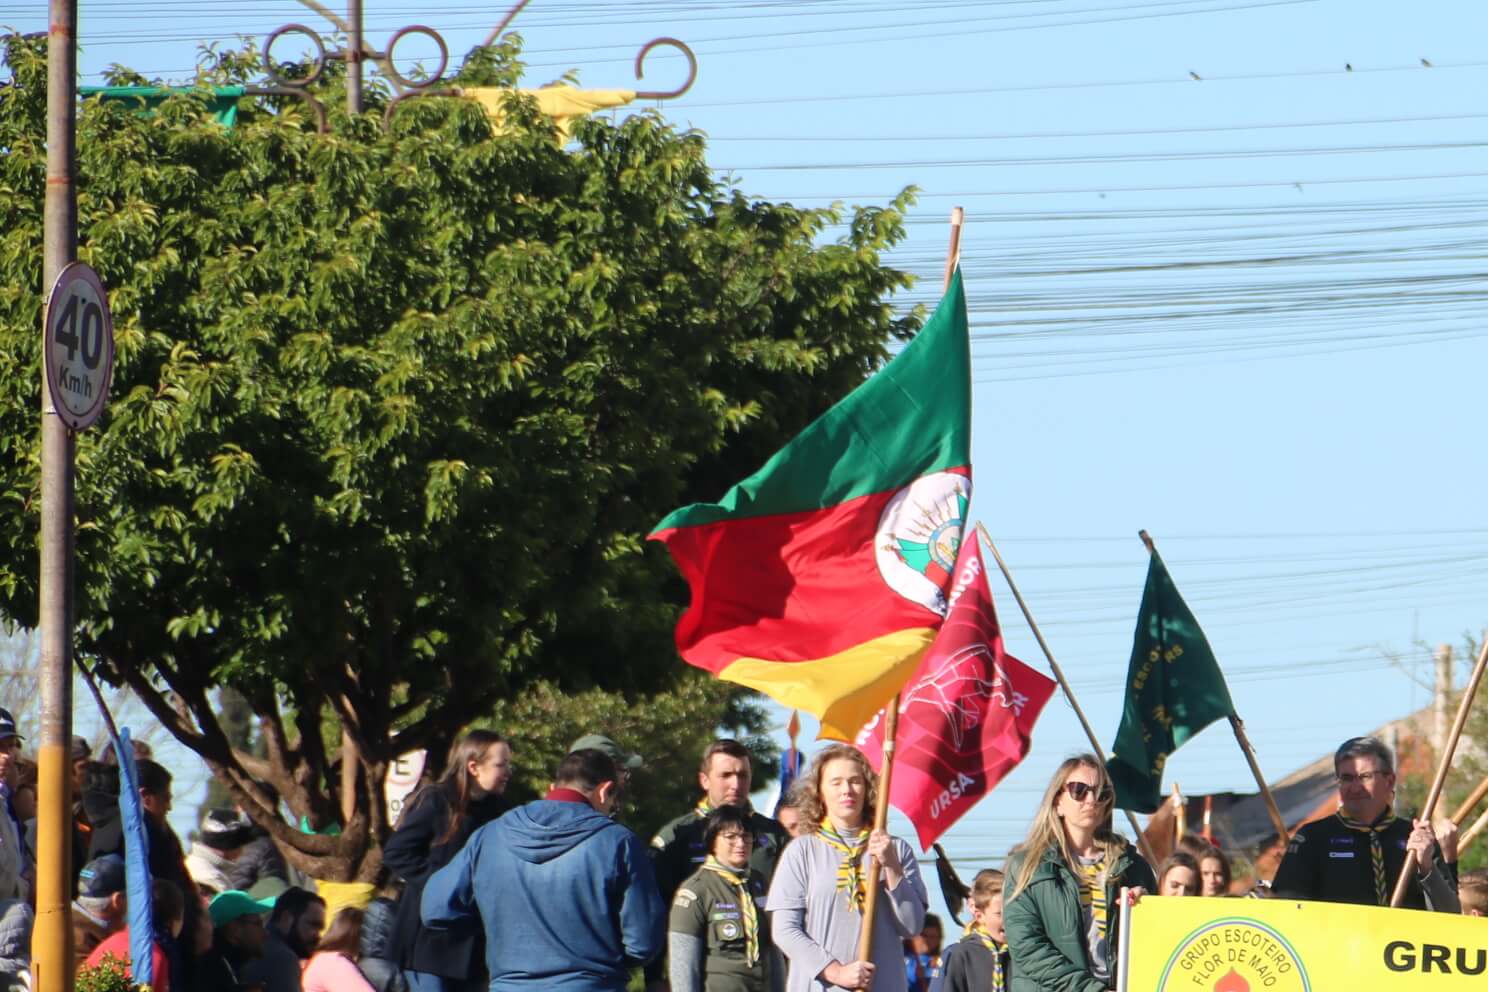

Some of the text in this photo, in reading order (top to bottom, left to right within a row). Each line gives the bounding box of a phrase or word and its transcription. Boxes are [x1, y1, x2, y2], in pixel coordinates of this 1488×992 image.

[55, 294, 101, 370] 40
[59, 366, 92, 399] Km/h
[929, 770, 975, 821] URSA
[1181, 928, 1292, 975] GRUPO ESCOTEIRO
[1192, 948, 1277, 988] FLOR DE MAIO
